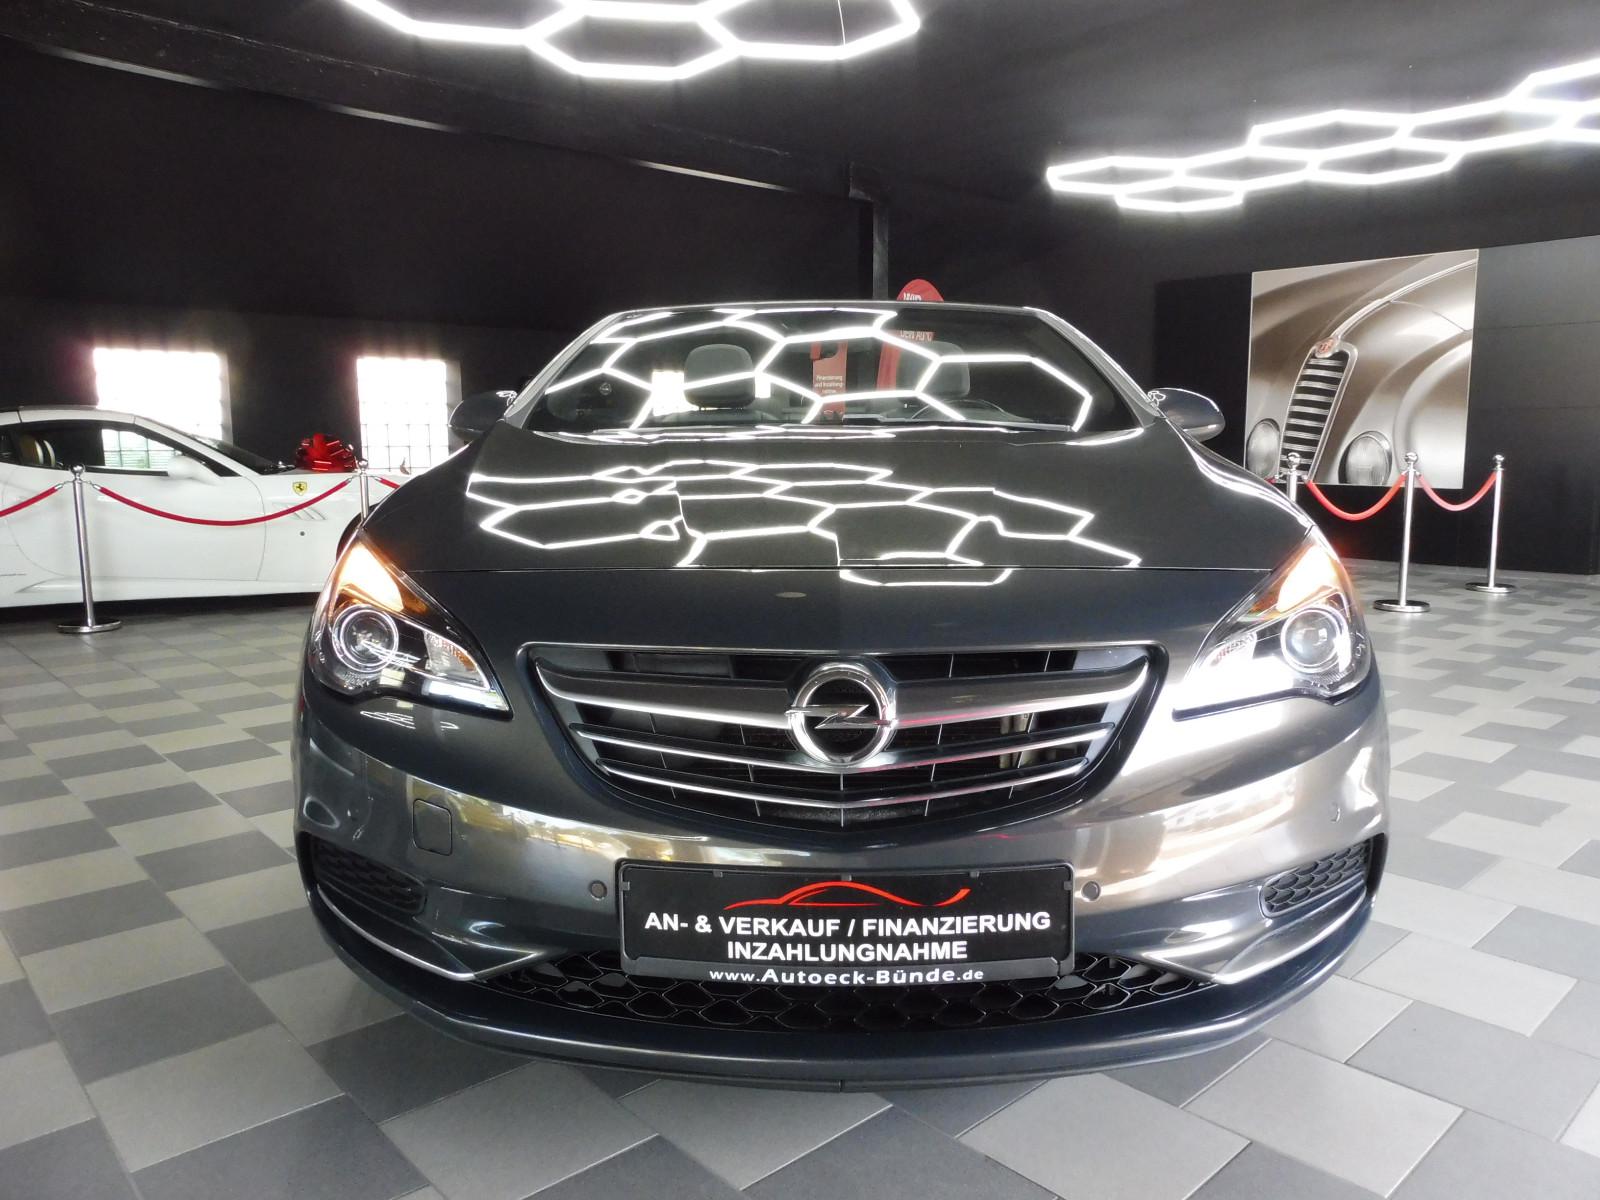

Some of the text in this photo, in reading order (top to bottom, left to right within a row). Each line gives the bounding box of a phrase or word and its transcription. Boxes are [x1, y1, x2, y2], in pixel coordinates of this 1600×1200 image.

[645, 911, 1051, 938] AN- & VERKAUF / FINANZIERUNG
[727, 940, 968, 963] INZAHLUNGNAHME
[708, 967, 985, 985] www.Autoeck-Bünde.de
